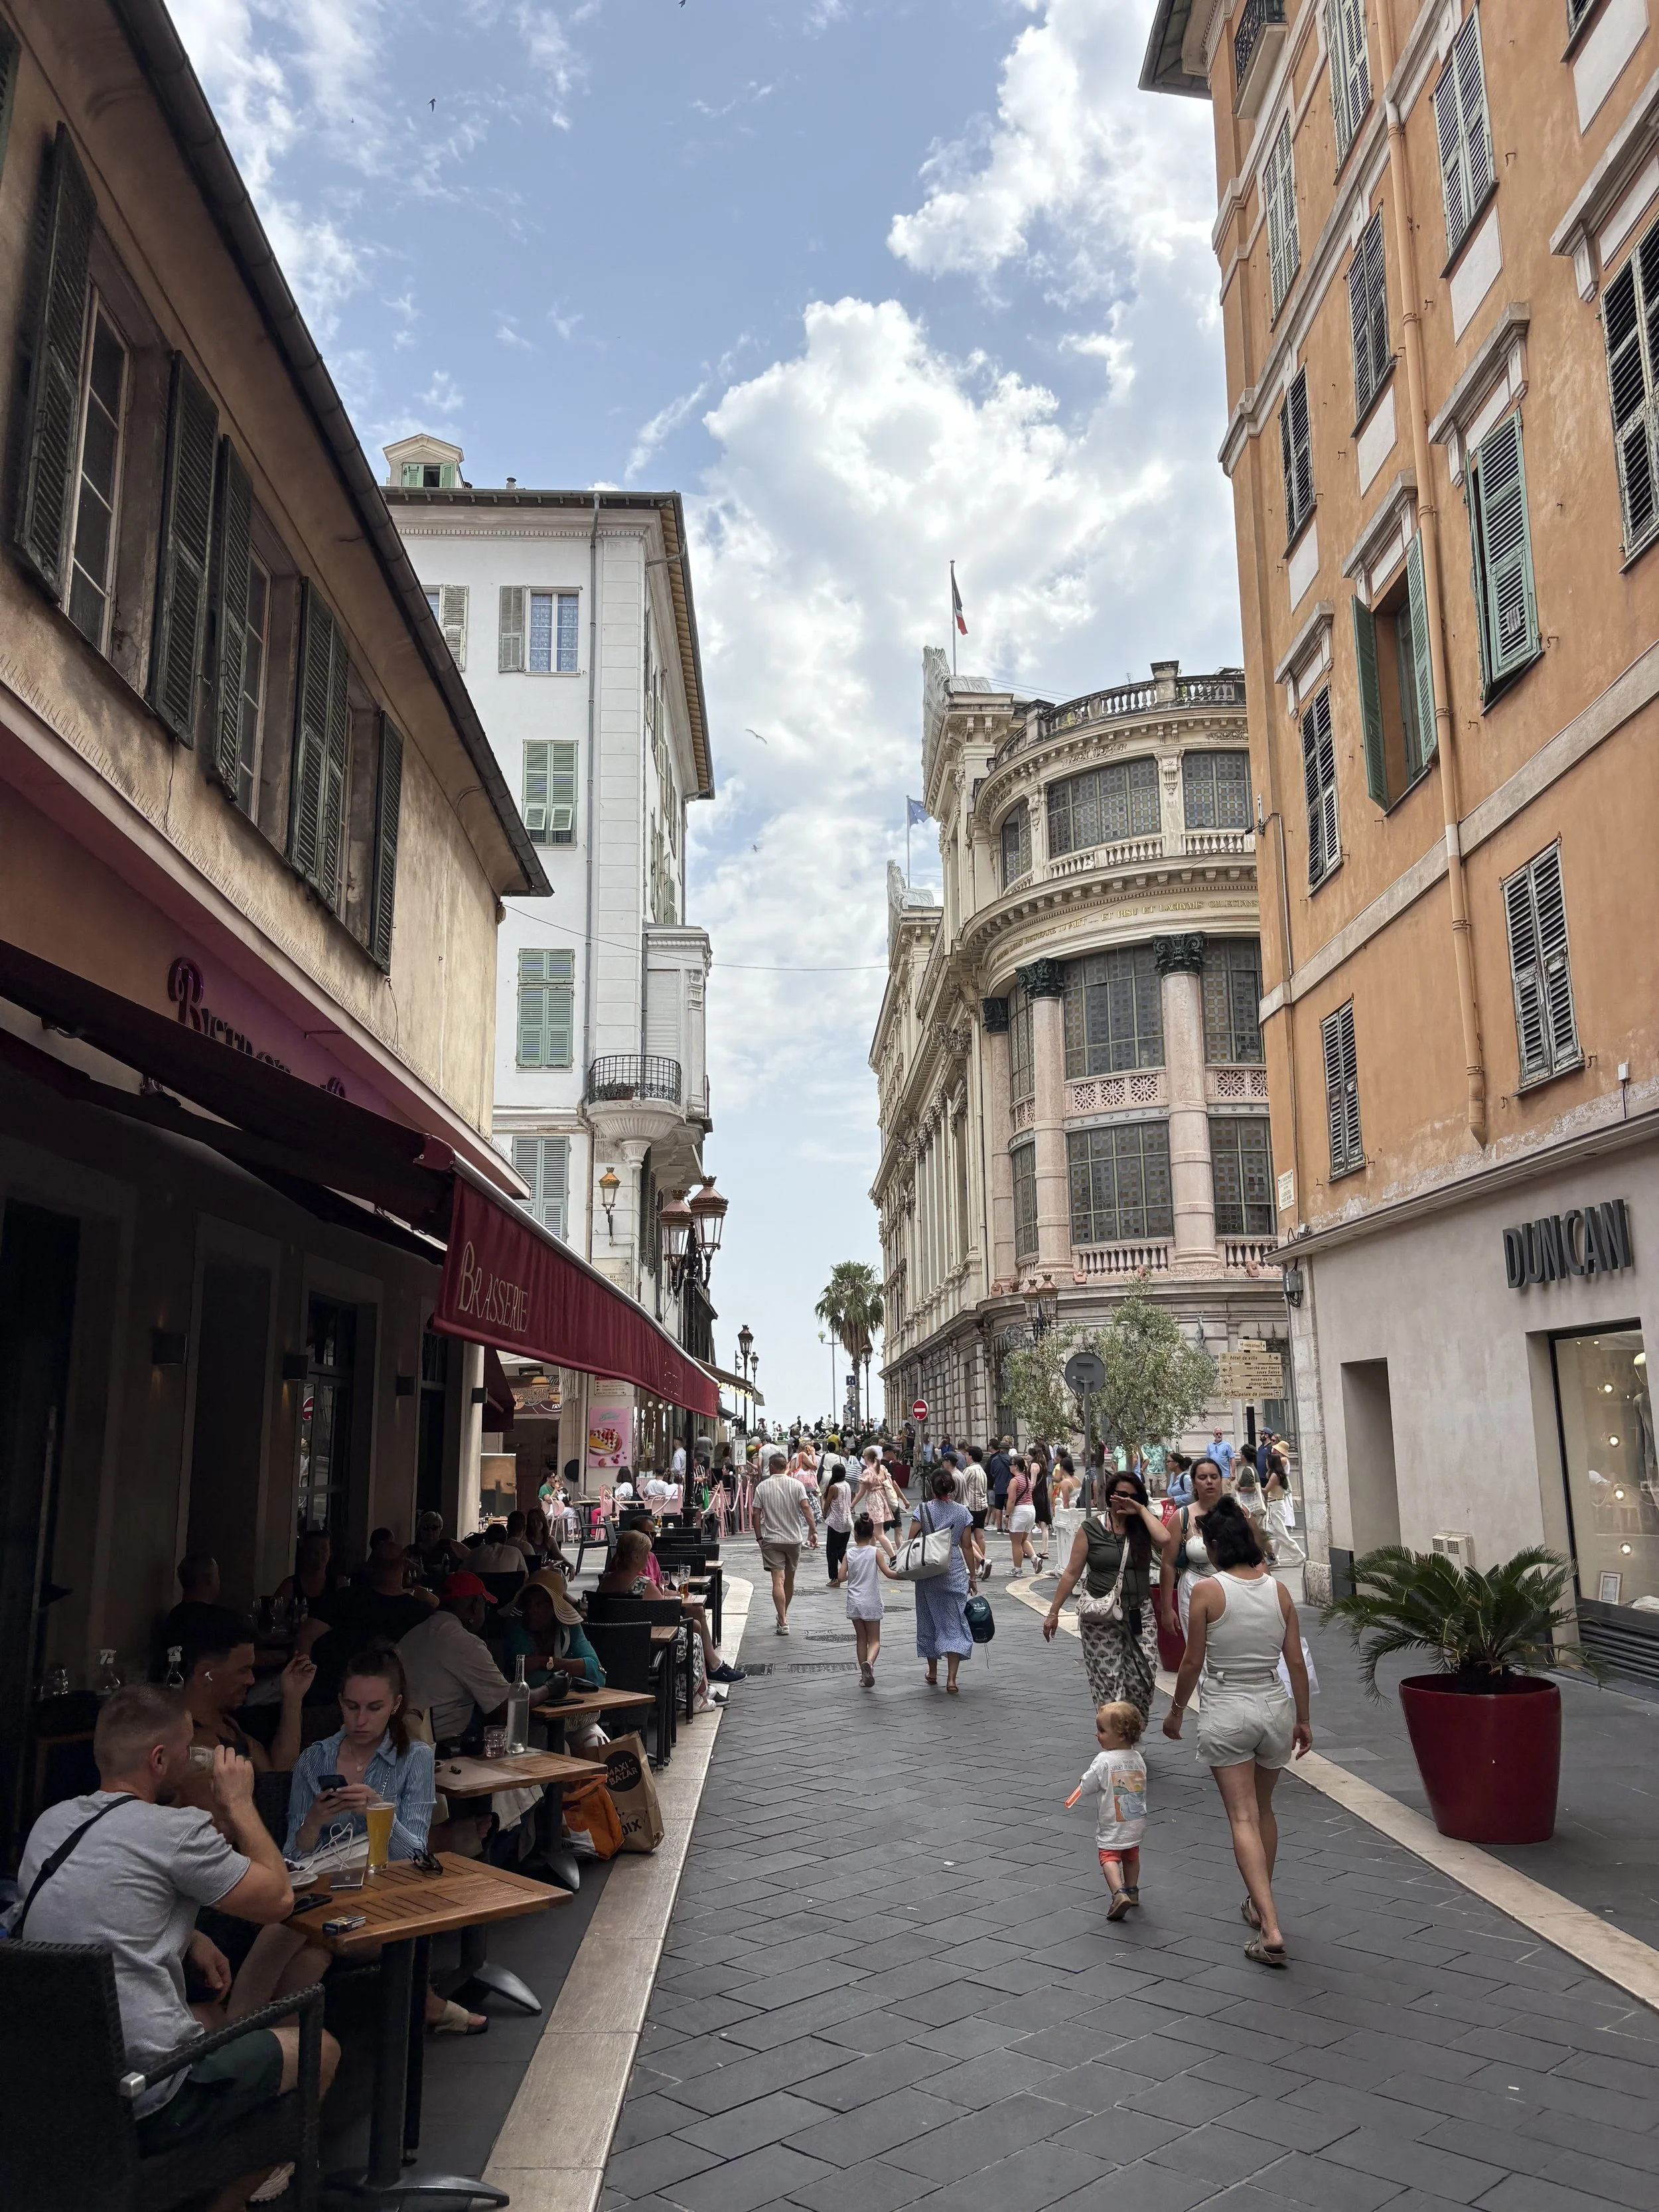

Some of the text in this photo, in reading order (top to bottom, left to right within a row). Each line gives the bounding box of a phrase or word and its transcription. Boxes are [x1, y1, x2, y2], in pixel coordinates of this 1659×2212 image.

[1101, 913, 1114, 921] ET
[1118, 908, 1138, 918] RISU
[1159, 901, 1204, 912] LACRYMIS
[1502, 1199, 1630, 1288] DUNCAN
[458, 1240, 528, 1332] BRASSERIE
[609, 1767, 638, 1786] BAZAR
